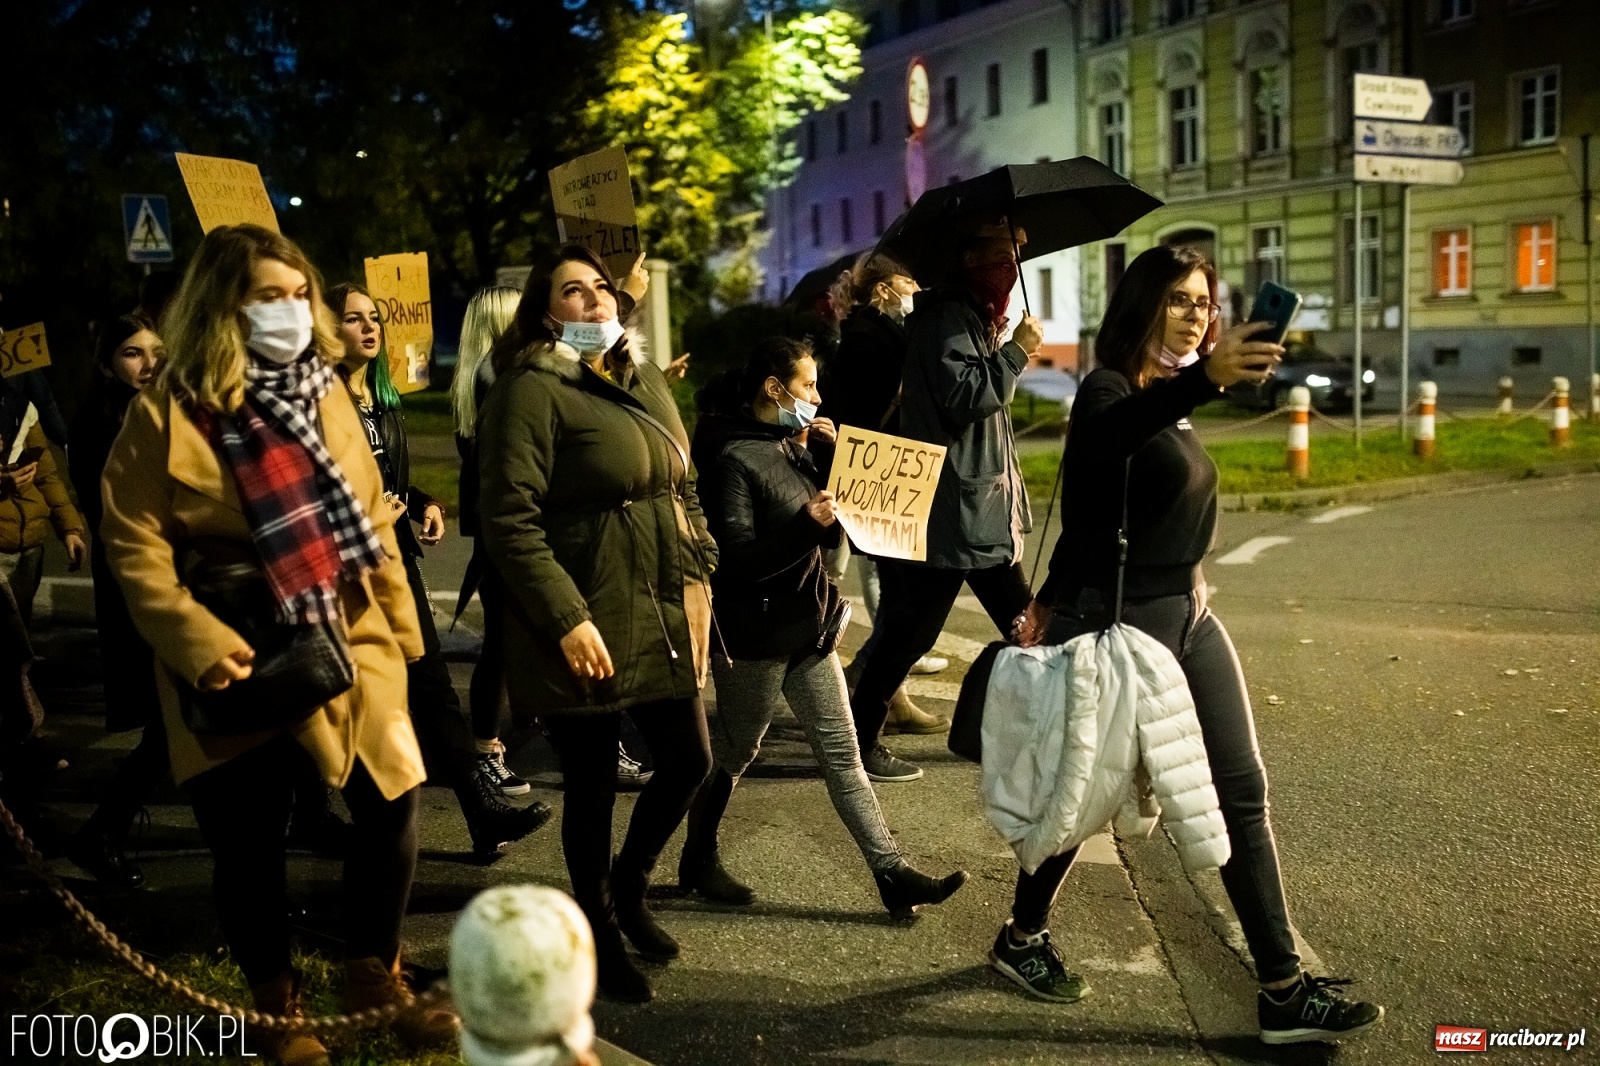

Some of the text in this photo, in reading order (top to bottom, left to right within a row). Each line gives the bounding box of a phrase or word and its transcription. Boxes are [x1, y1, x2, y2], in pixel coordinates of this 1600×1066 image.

[0, 330, 43, 372] ŚĆ!
[847, 436, 942, 481] TO JEST
[835, 476, 922, 518] WOJNA Z
